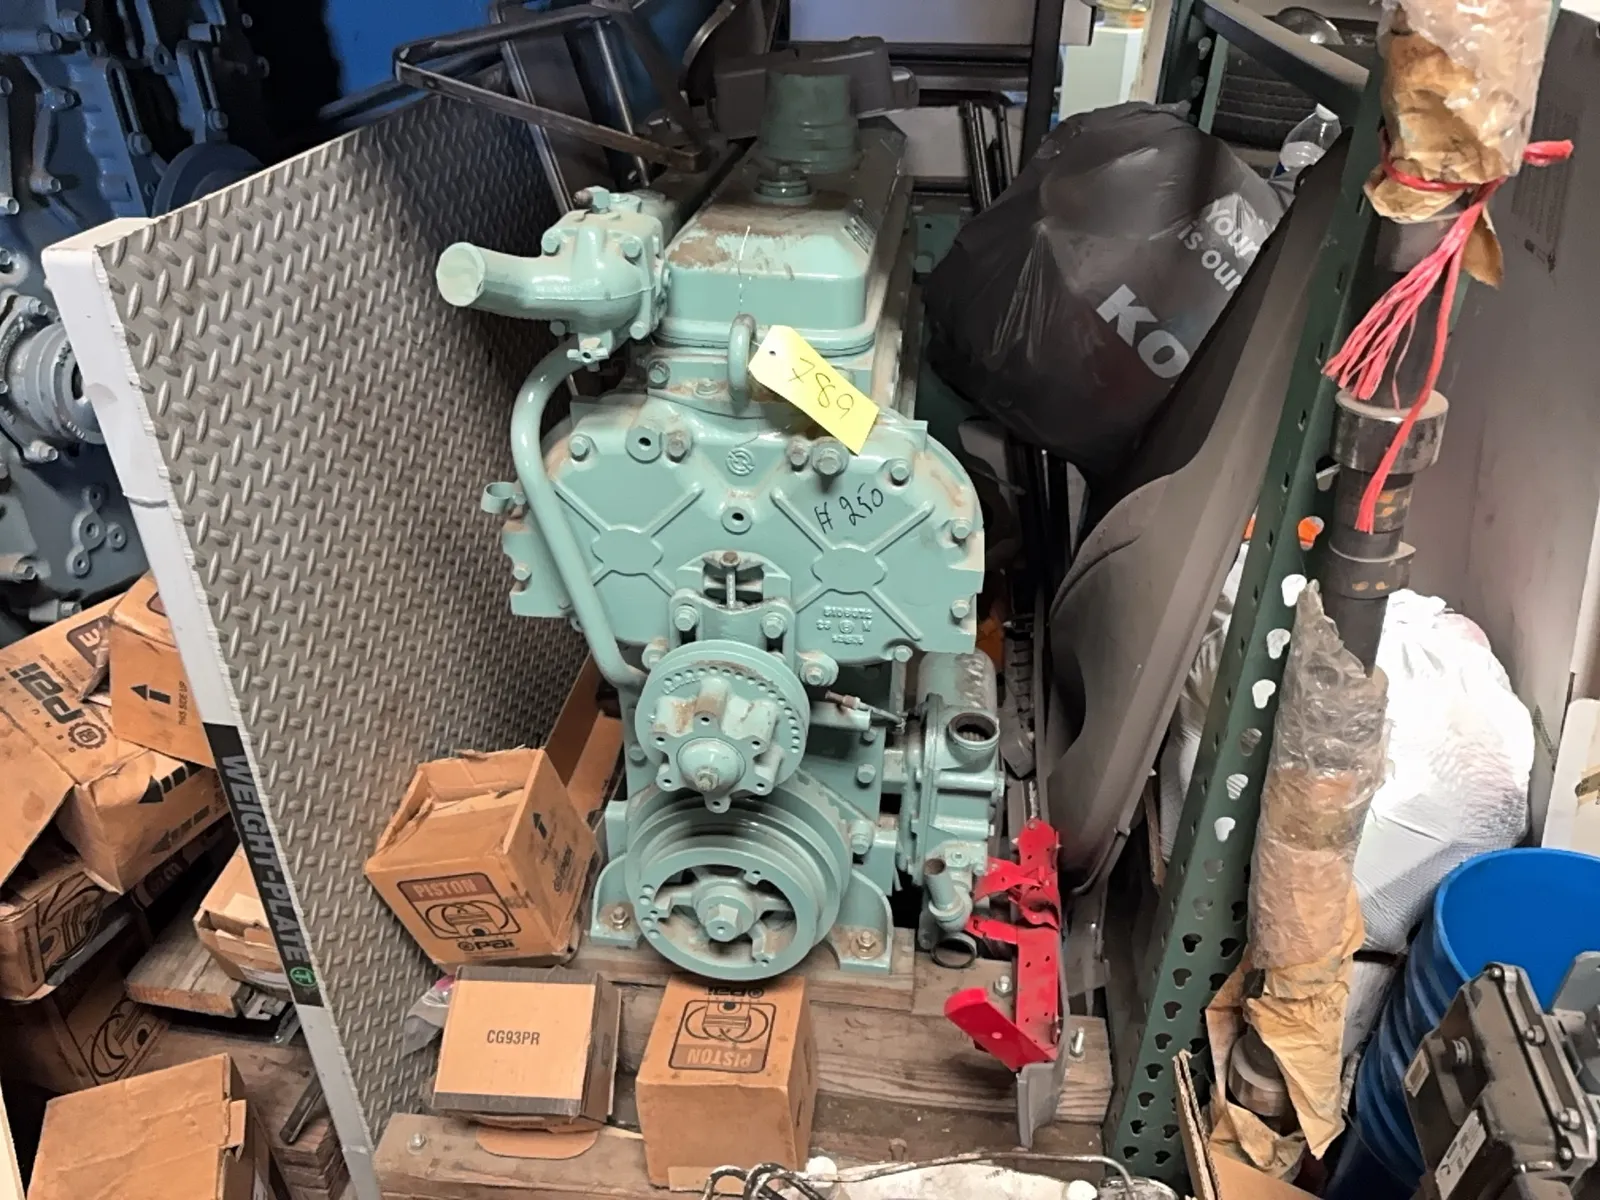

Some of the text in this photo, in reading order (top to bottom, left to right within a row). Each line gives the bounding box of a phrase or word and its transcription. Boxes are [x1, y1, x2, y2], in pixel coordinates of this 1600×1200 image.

[1177, 221, 1242, 291] is our
[221, 755, 309, 963] WEIGHT-PLATE
[412, 878, 478, 898] PISTON
[486, 1029, 541, 1046] CG93PR
[686, 1048, 753, 1069] PISTON
